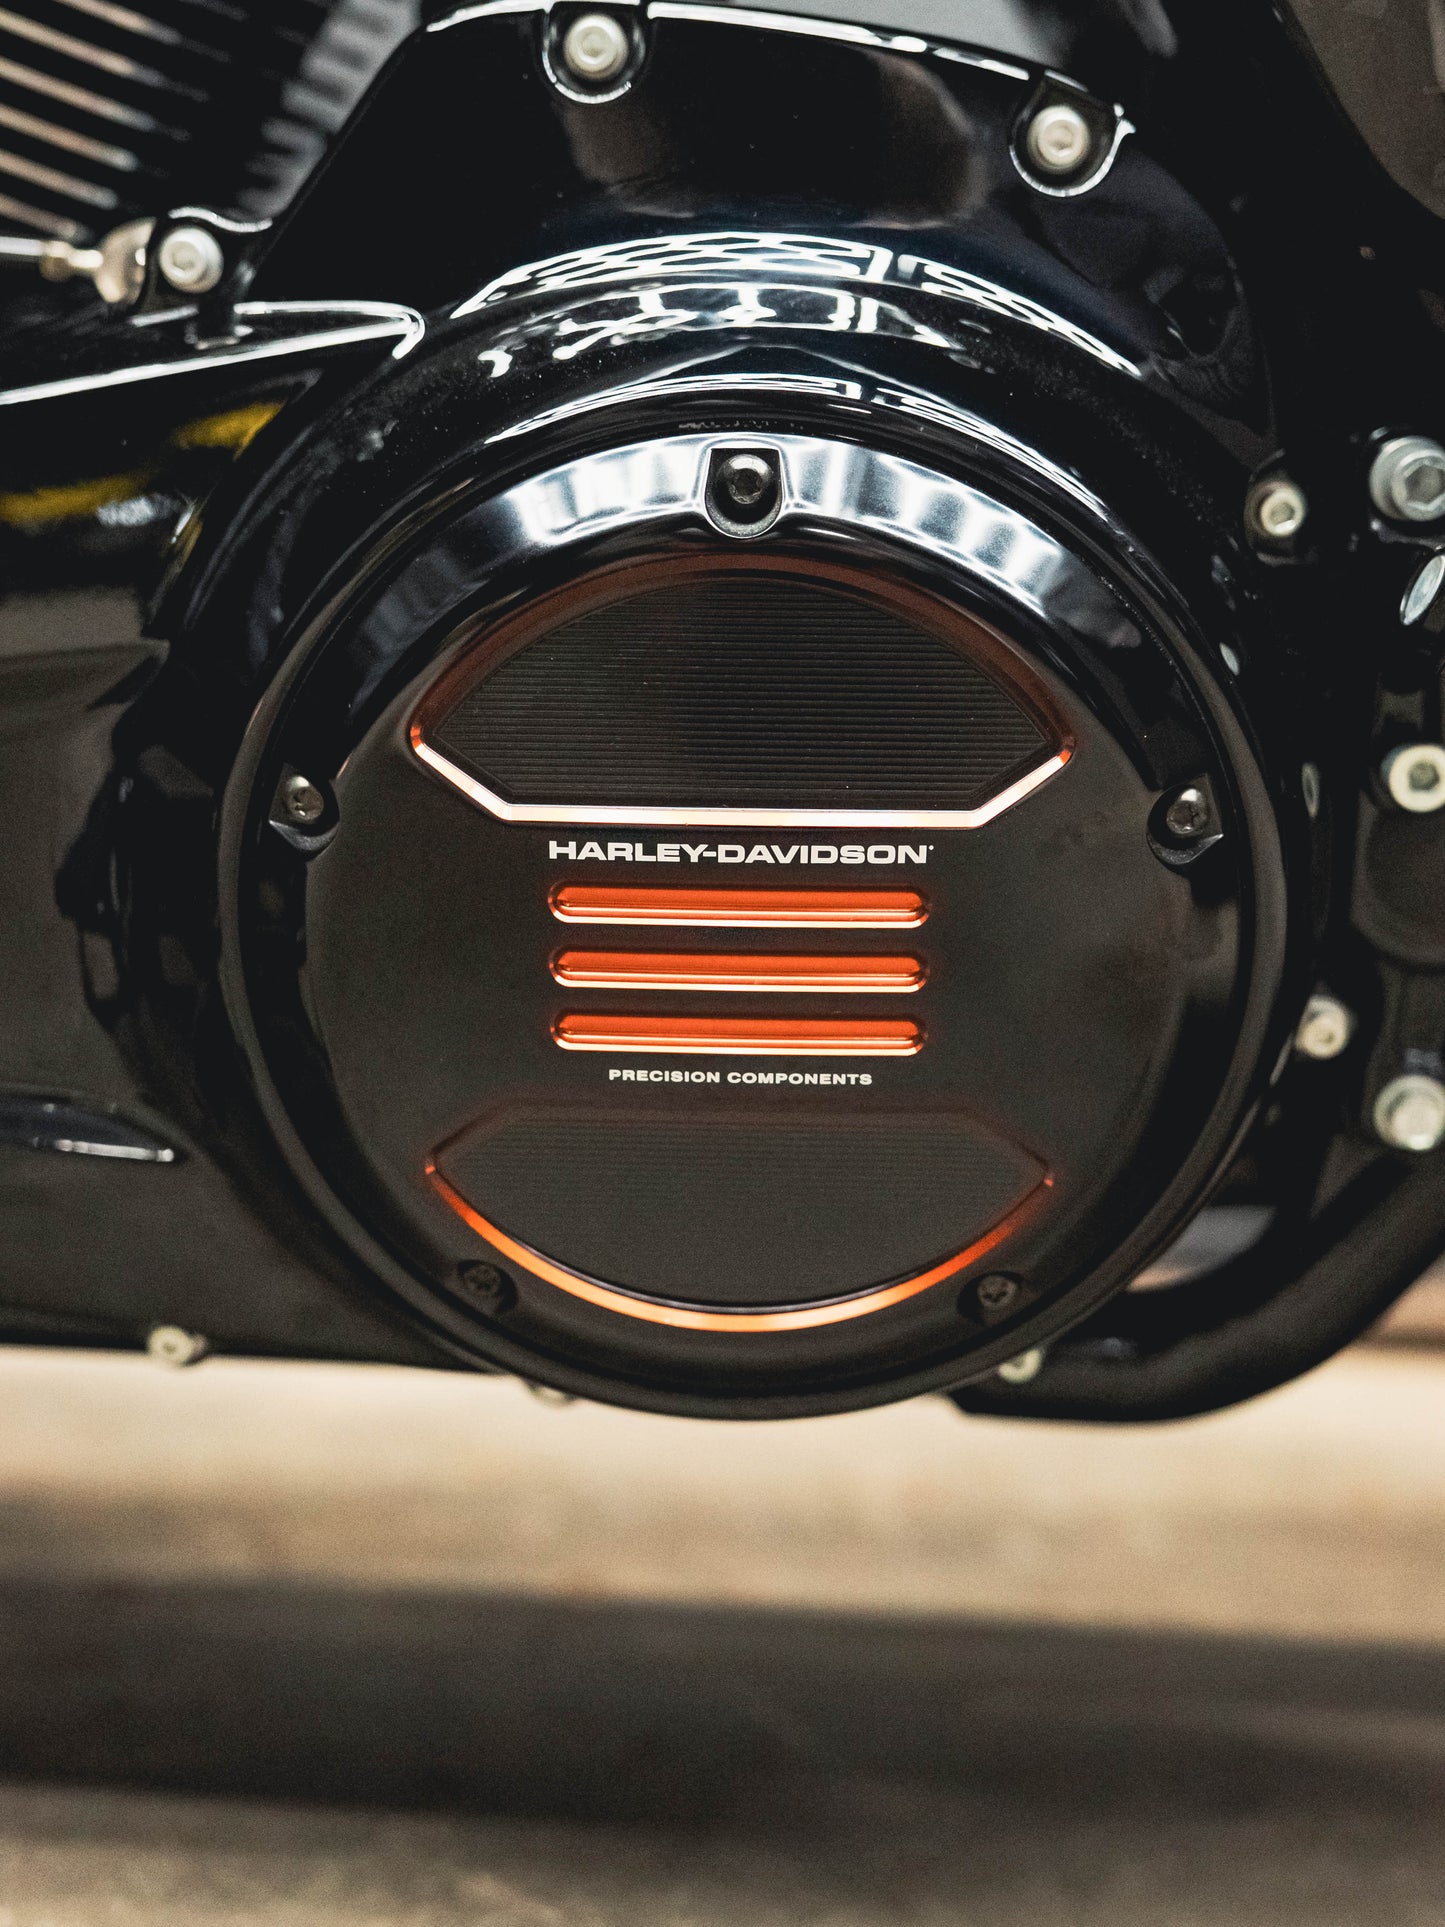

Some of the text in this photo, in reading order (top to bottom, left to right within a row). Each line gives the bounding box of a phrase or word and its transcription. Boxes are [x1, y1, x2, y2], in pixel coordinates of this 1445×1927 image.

[548, 840, 929, 864] HARLEY-DAVIDSON
[608, 1068, 873, 1086] PRECISION COMPONENTS
